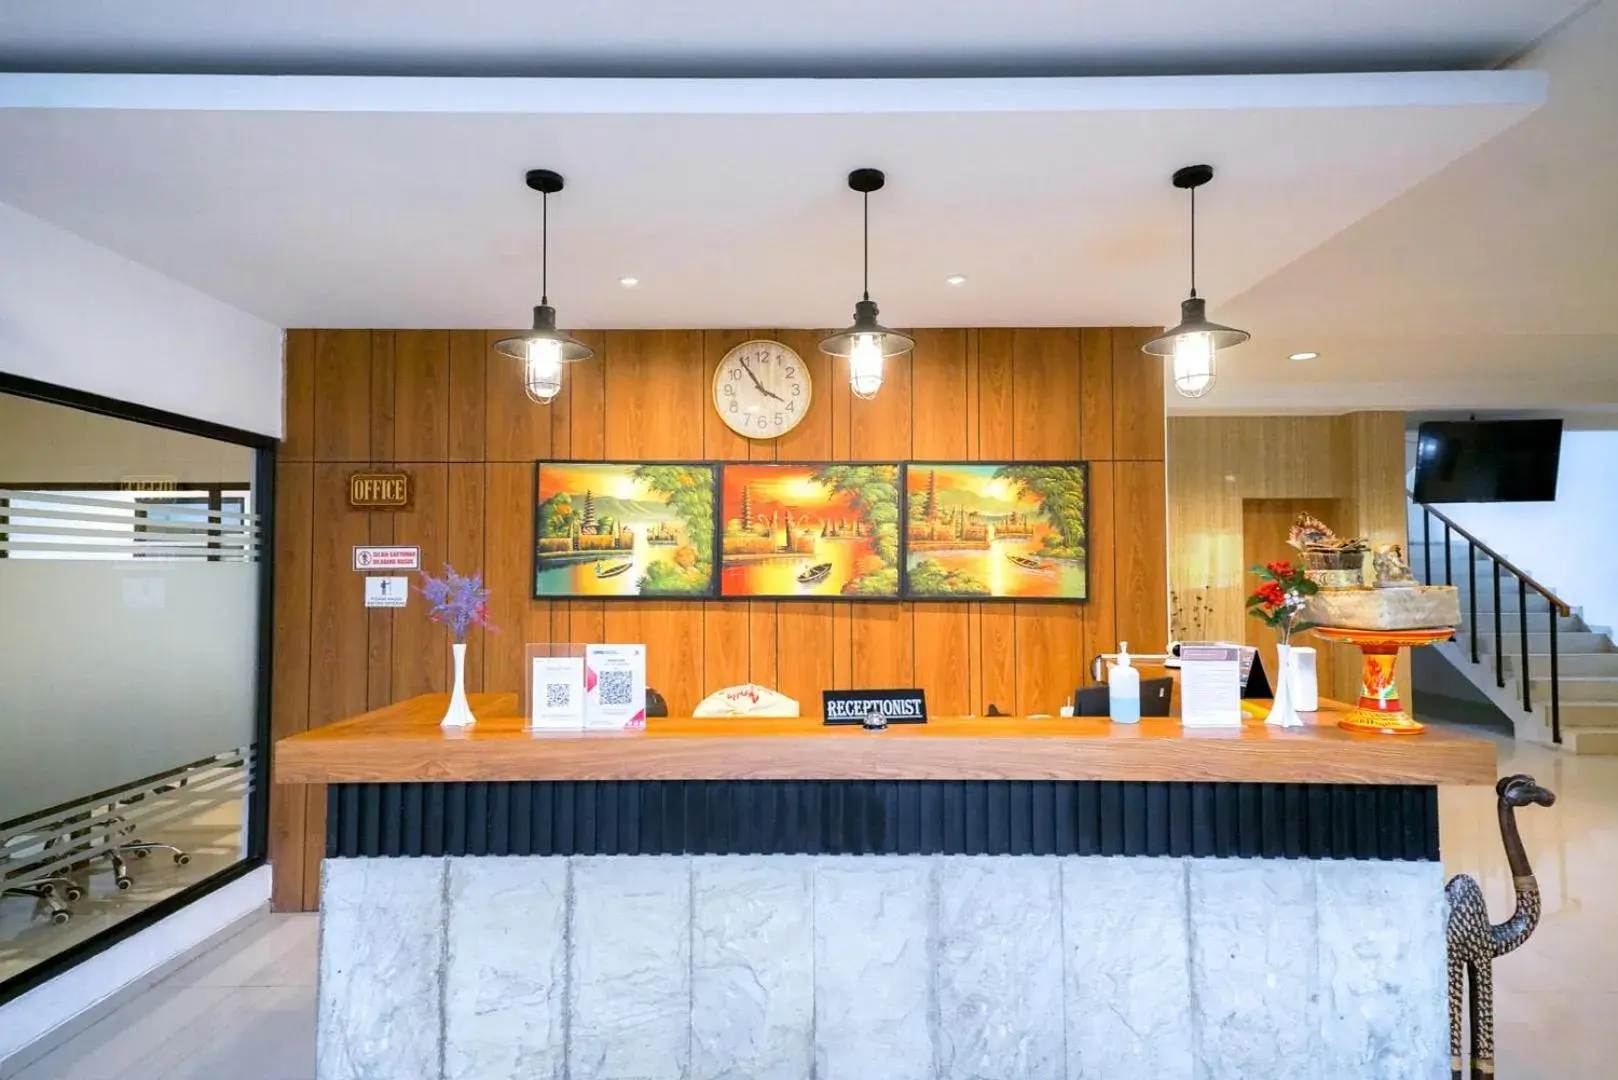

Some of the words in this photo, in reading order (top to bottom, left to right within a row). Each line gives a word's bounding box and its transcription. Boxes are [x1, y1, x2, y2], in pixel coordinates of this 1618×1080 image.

[755, 351, 770, 364] 12
[776, 354, 782, 367] 1
[728, 368, 742, 381] 10
[785, 366, 795, 379] 2
[723, 384, 734, 397] 9
[792, 383, 800, 396] 3
[729, 401, 738, 414] 8
[785, 400, 794, 413] 4
[743, 412, 751, 427] 7
[757, 416, 767, 429] 6
[774, 412, 783, 426] 5
[354, 479, 404, 500] OFFICE
[827, 699, 922, 717] RECEPTIONIST
